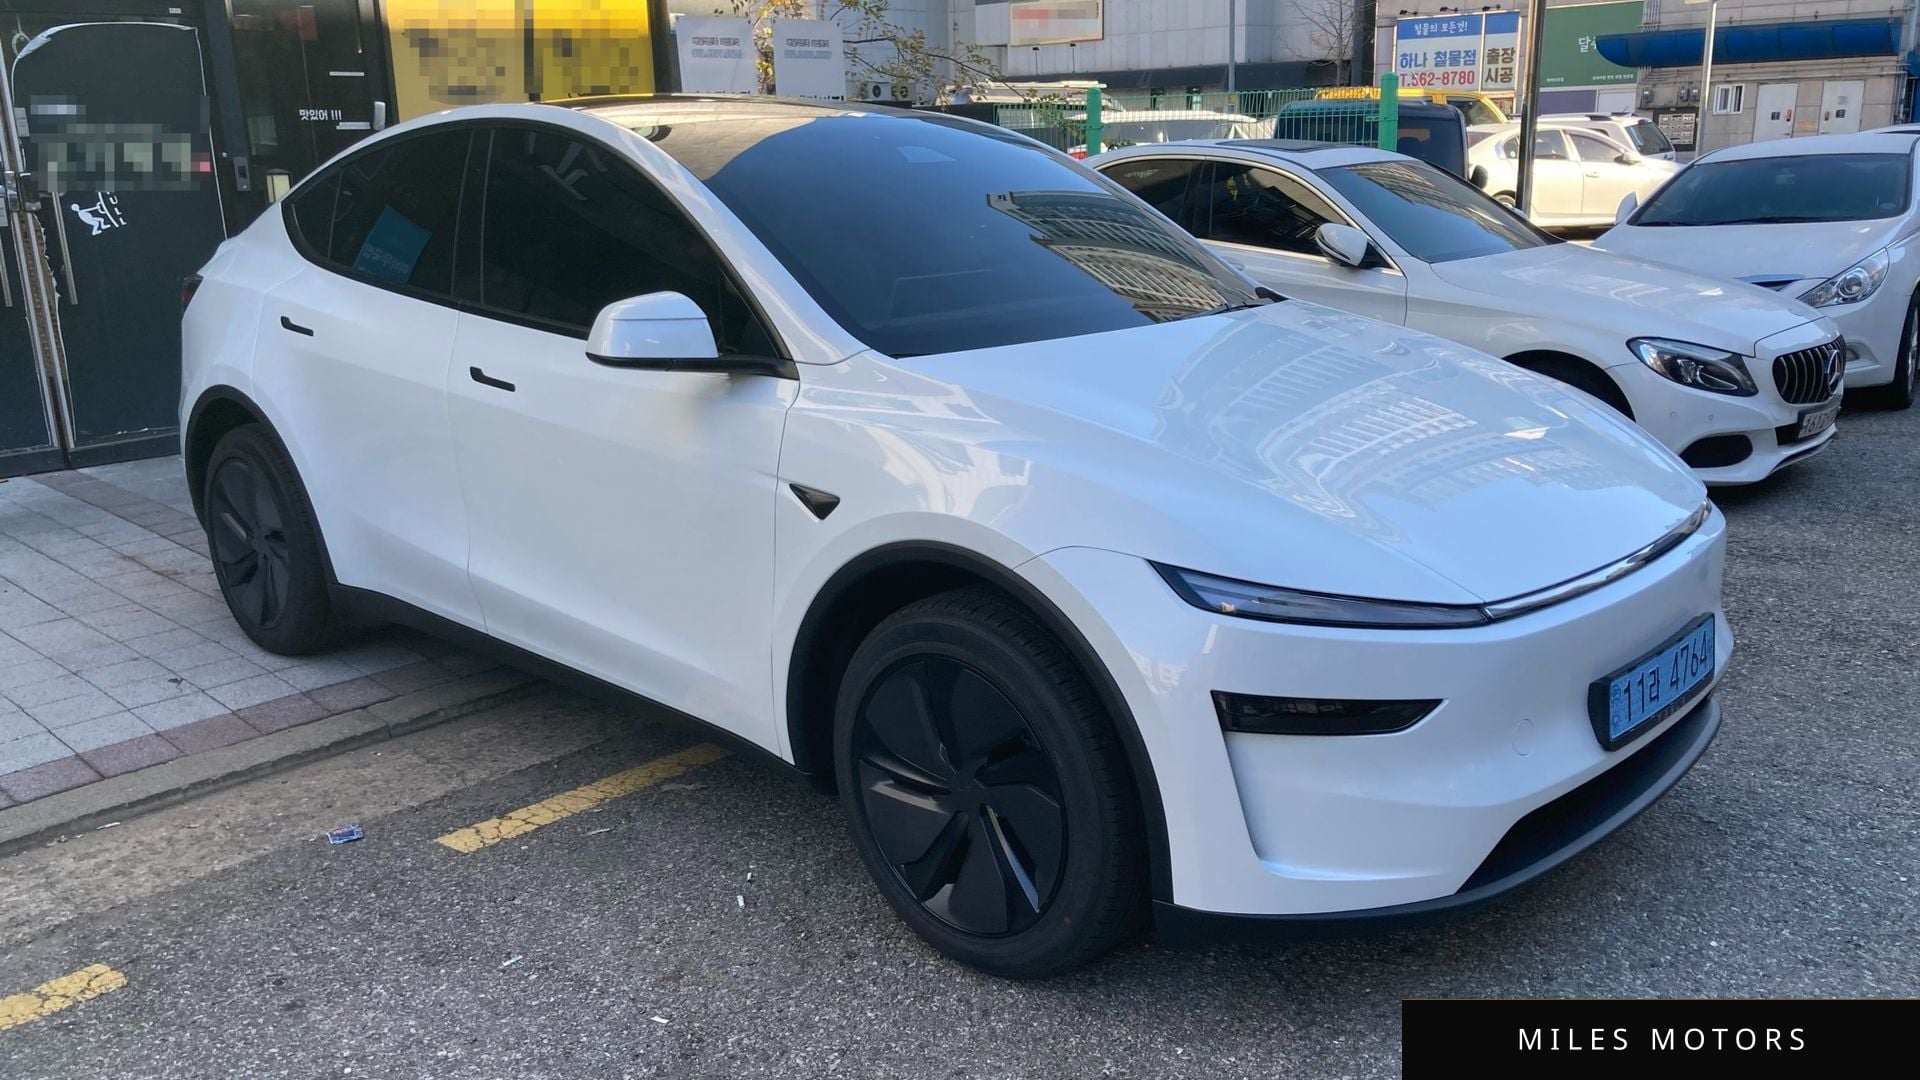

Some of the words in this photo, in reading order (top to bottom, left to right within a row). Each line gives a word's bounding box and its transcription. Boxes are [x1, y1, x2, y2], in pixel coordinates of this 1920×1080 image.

[1440, 20, 1467, 33] 모든것!
[1400, 52, 1428, 69] 하나
[1434, 49, 1477, 67] 철물점
[1487, 47, 1516, 65] 출장
[1400, 70, 1475, 87] T.562-8780
[1485, 67, 1514, 84] 시공
[299, 109, 328, 121] 맛있어
[1623, 666, 1660, 722] 11라
[1669, 630, 1708, 690] 4764
